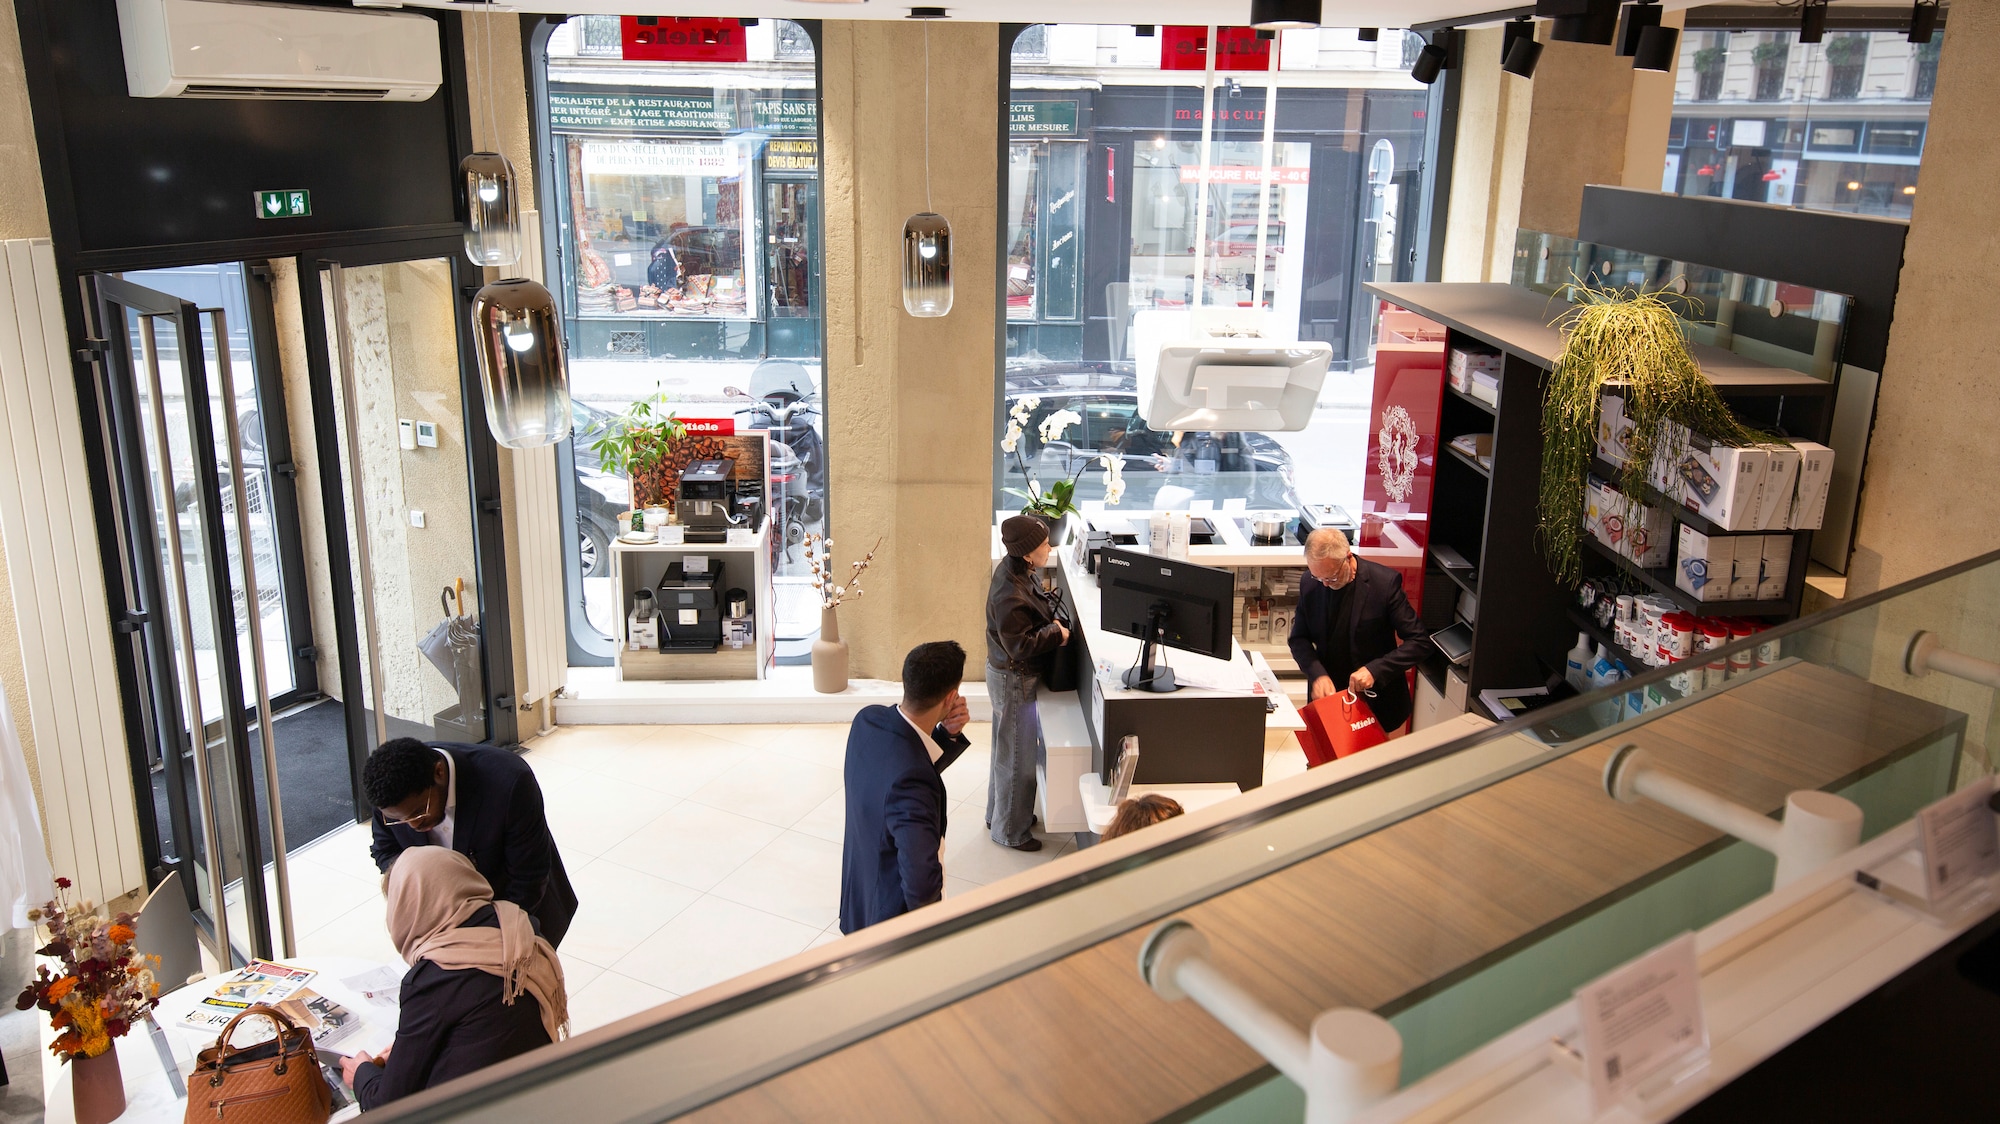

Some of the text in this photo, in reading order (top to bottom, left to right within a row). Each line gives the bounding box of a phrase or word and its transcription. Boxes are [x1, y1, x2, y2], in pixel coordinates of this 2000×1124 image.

[608, 98, 620, 106] DE
[622, 99, 635, 107] LA
[638, 99, 712, 109] RESTAURATION
[756, 102, 782, 114] TAPIS
[783, 103, 806, 115] SANS
[569, 106, 611, 116] INTÉGRÉ
[663, 111, 732, 120] TRADITIONNEL
[560, 117, 602, 125] GRATUIT
[667, 120, 731, 129] ASSURANCES
[768, 156, 786, 167] DEVIS
[787, 157, 814, 169] GRATUIT
[1287, 171, 1299, 181] 40
[682, 422, 719, 432] Miele
[1107, 557, 1131, 567] Lenovo
[1350, 717, 1376, 732] Miele
